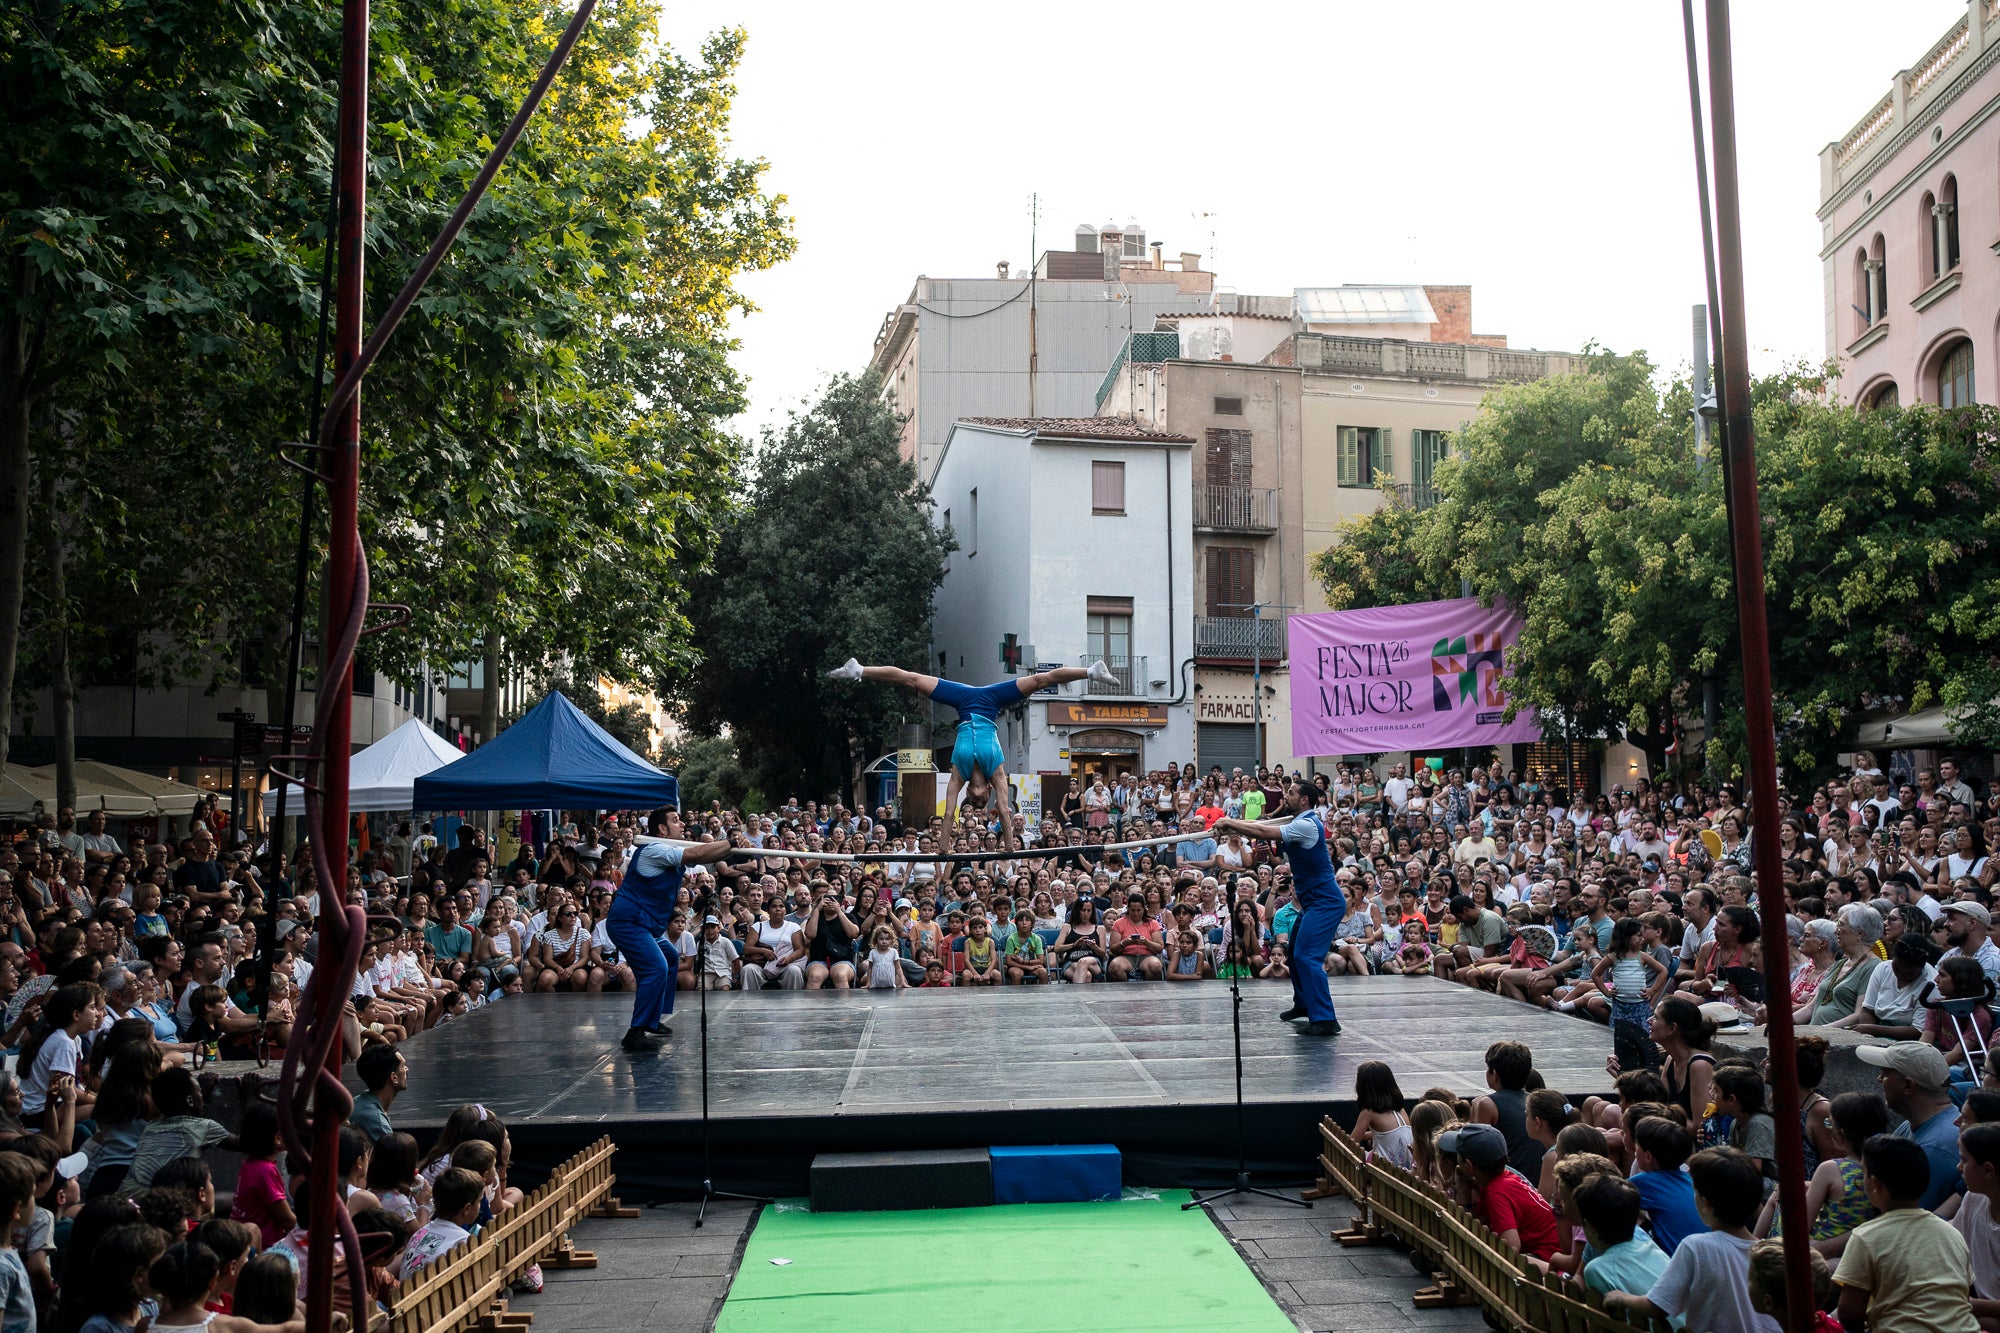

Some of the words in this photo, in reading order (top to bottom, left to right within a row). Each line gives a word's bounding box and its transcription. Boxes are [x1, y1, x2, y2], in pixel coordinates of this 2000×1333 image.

[1317, 643, 1392, 680] FESTA
[1319, 680, 1413, 717] MAJOR
[1093, 706, 1149, 718] TABACS
[1320, 722, 1426, 735] FESTAMAJORTERRASSA.CAT
